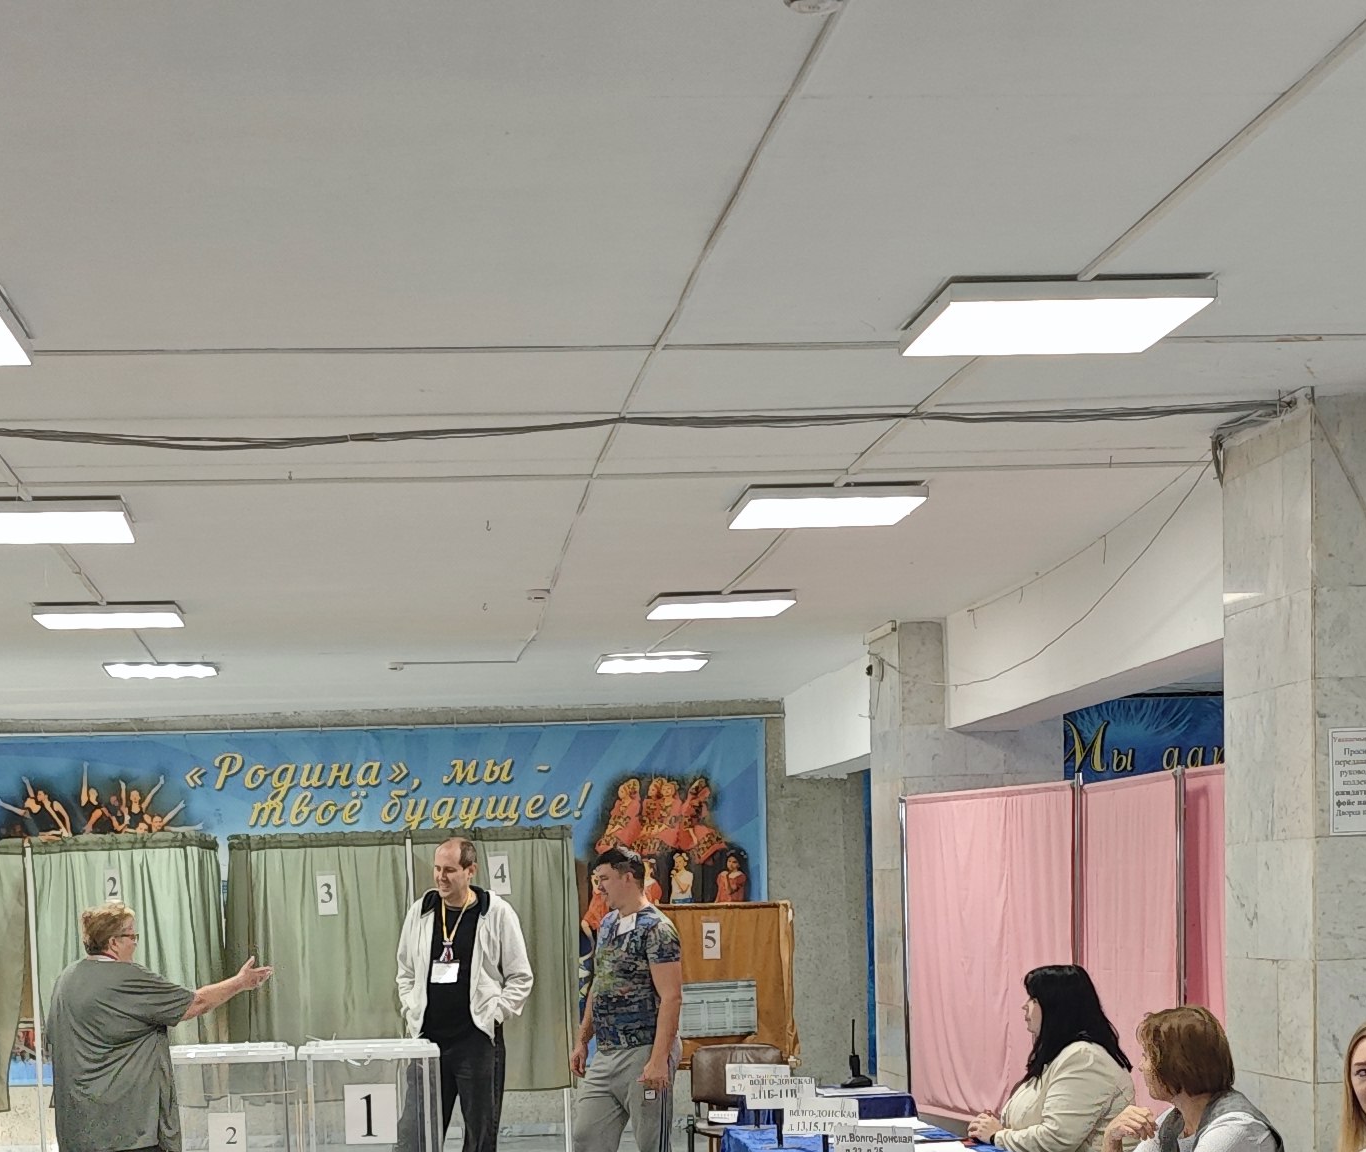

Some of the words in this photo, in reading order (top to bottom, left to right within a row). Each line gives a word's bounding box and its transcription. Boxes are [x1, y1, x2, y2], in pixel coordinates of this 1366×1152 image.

[1063, 720, 1135, 772] Мы
[184, 751, 422, 802] «Родина»,
[441, 758, 515, 784] мы
[248, 787, 365, 827] твоё
[381, 780, 595, 830] будущее!
[1336, 798, 1355, 808] фойе
[493, 864, 507, 884] 4
[106, 876, 119, 898] 2
[320, 882, 333, 904] 3
[704, 929, 717, 949] 5
[360, 1094, 377, 1138] 1
[225, 1125, 238, 1146] 2
[835, 1132, 913, 1145] ул.Волго-Донская
